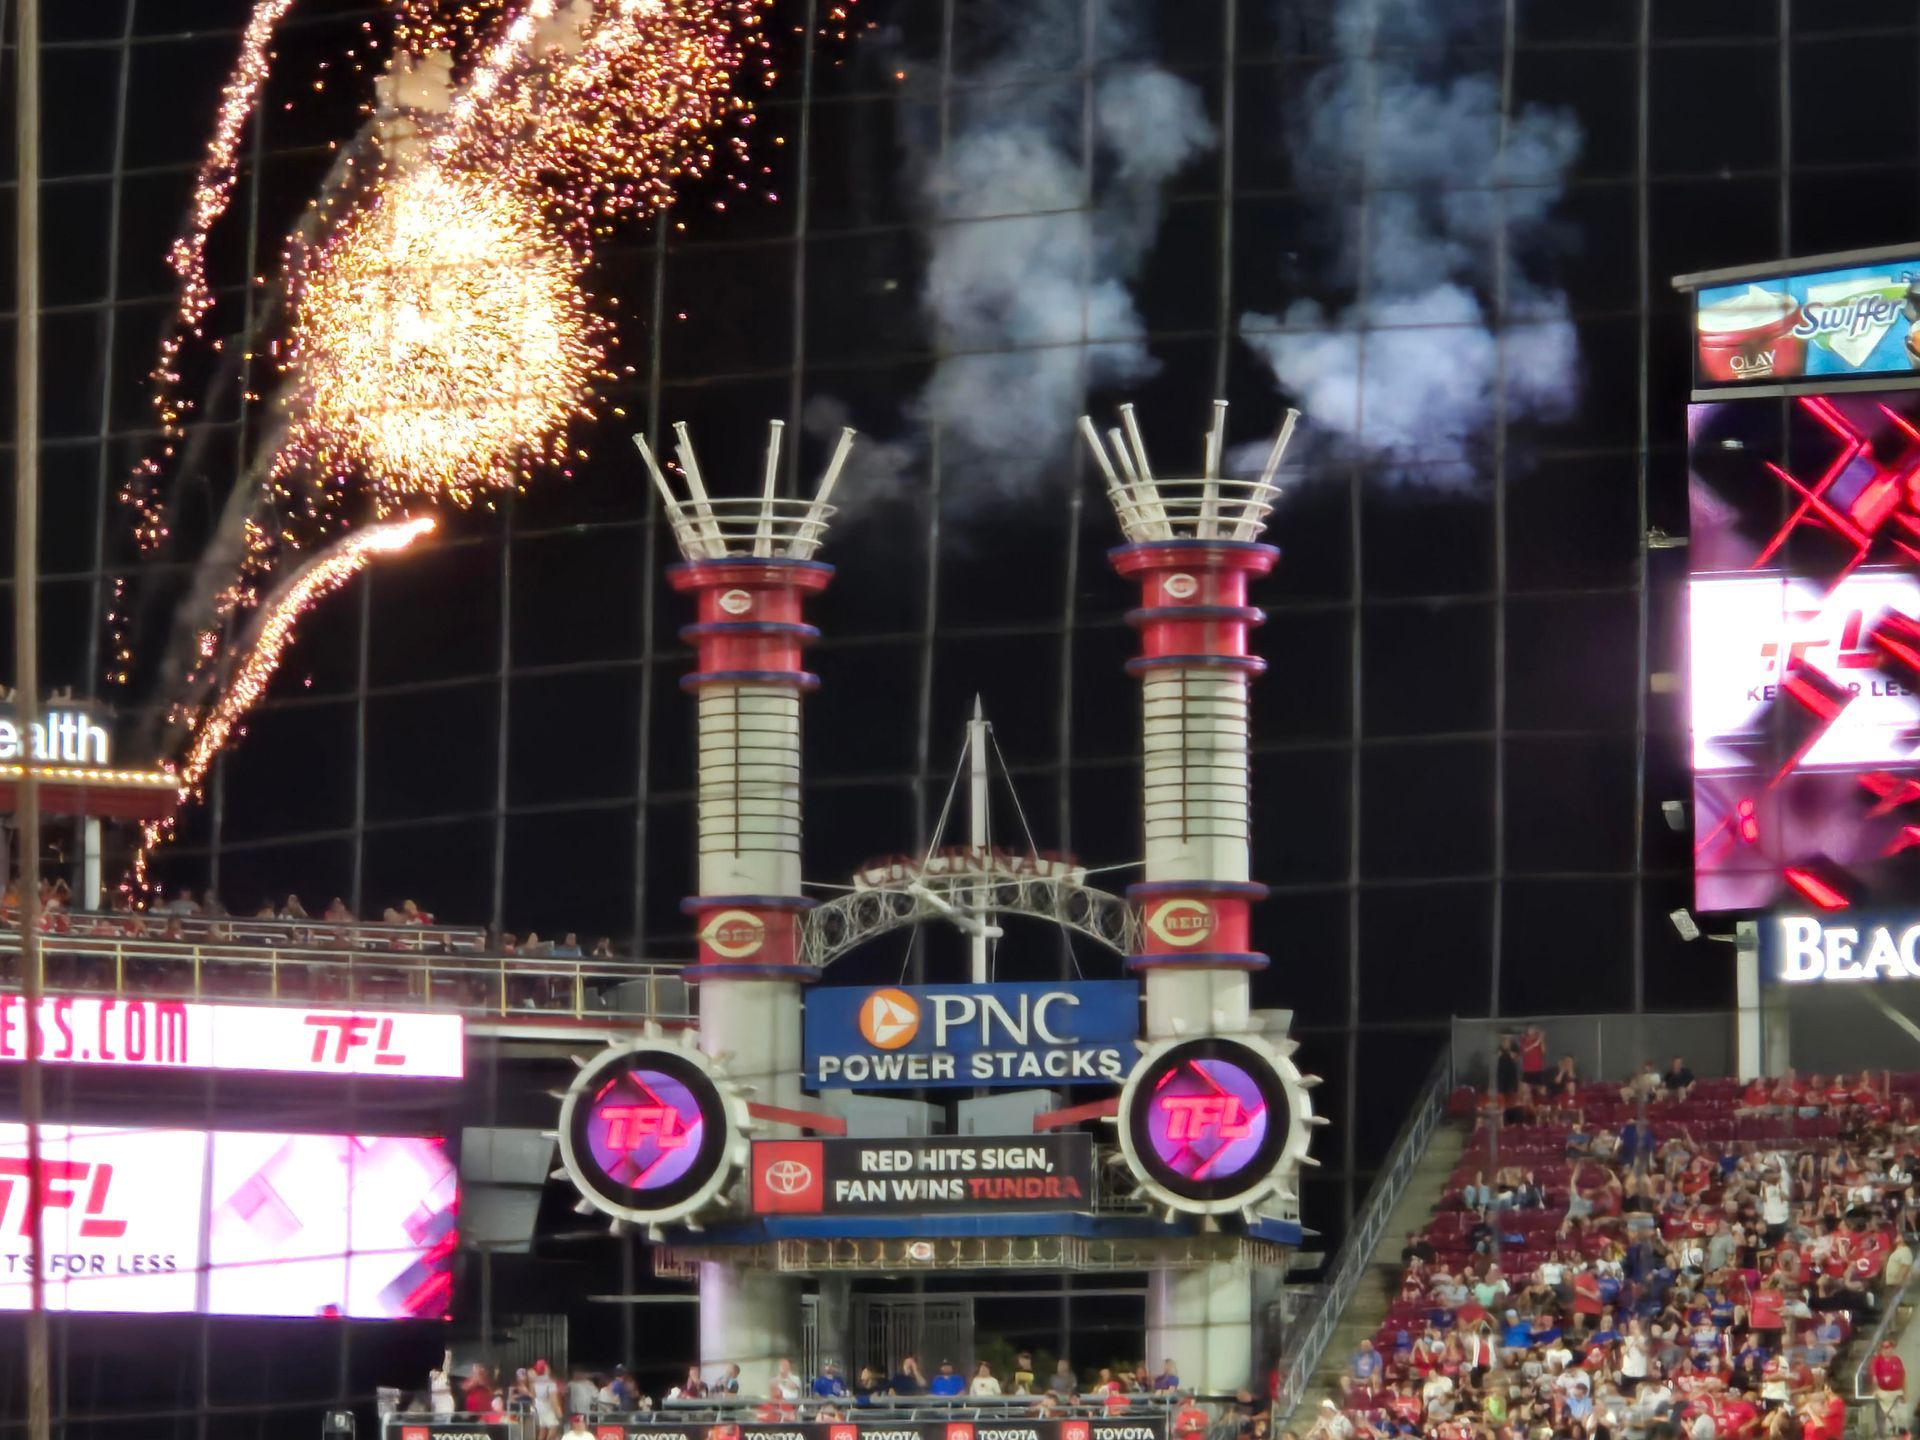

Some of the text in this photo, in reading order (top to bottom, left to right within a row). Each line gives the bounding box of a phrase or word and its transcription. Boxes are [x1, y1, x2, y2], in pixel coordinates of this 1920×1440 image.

[1795, 296, 1904, 336] Swiffer
[1730, 349, 1776, 370] OLAY
[926, 992, 1080, 1047] PNC
[304, 1015, 406, 1066] TFL
[819, 1049, 1122, 1082] POWER STACKS
[601, 1107, 690, 1150] TFL
[1161, 1096, 1251, 1139] TFL
[861, 1147, 1054, 1173] RED HITS SIGN,
[836, 1176, 1082, 1202] FAN WINS TUNDRA
[51, 1254, 105, 1273] FOR
[117, 1254, 177, 1273] LESS
[977, 1430, 1038, 1440] TOYOTA
[1094, 1427, 1155, 1440] TOYOTA
